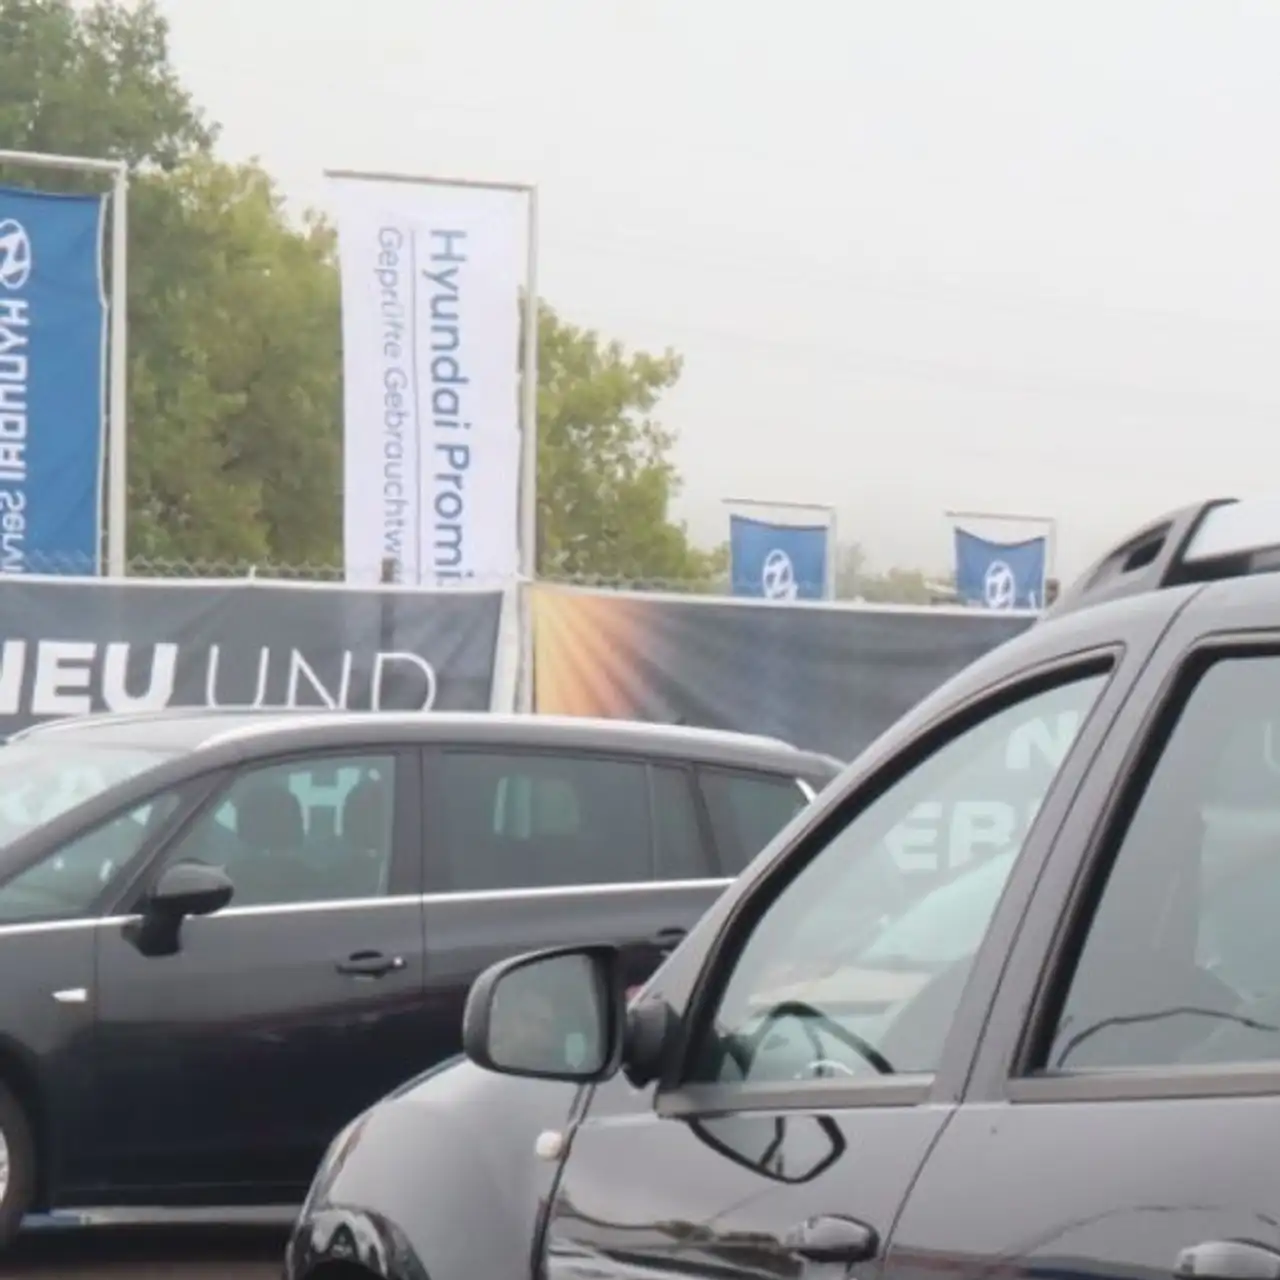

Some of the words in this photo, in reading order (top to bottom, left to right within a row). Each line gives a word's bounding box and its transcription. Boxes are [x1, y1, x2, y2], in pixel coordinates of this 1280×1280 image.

[374, 227, 403, 358] Geprüfte
[422, 229, 472, 430] Hyundai
[433, 443, 475, 586] Promi
[206, 645, 437, 712] UND
